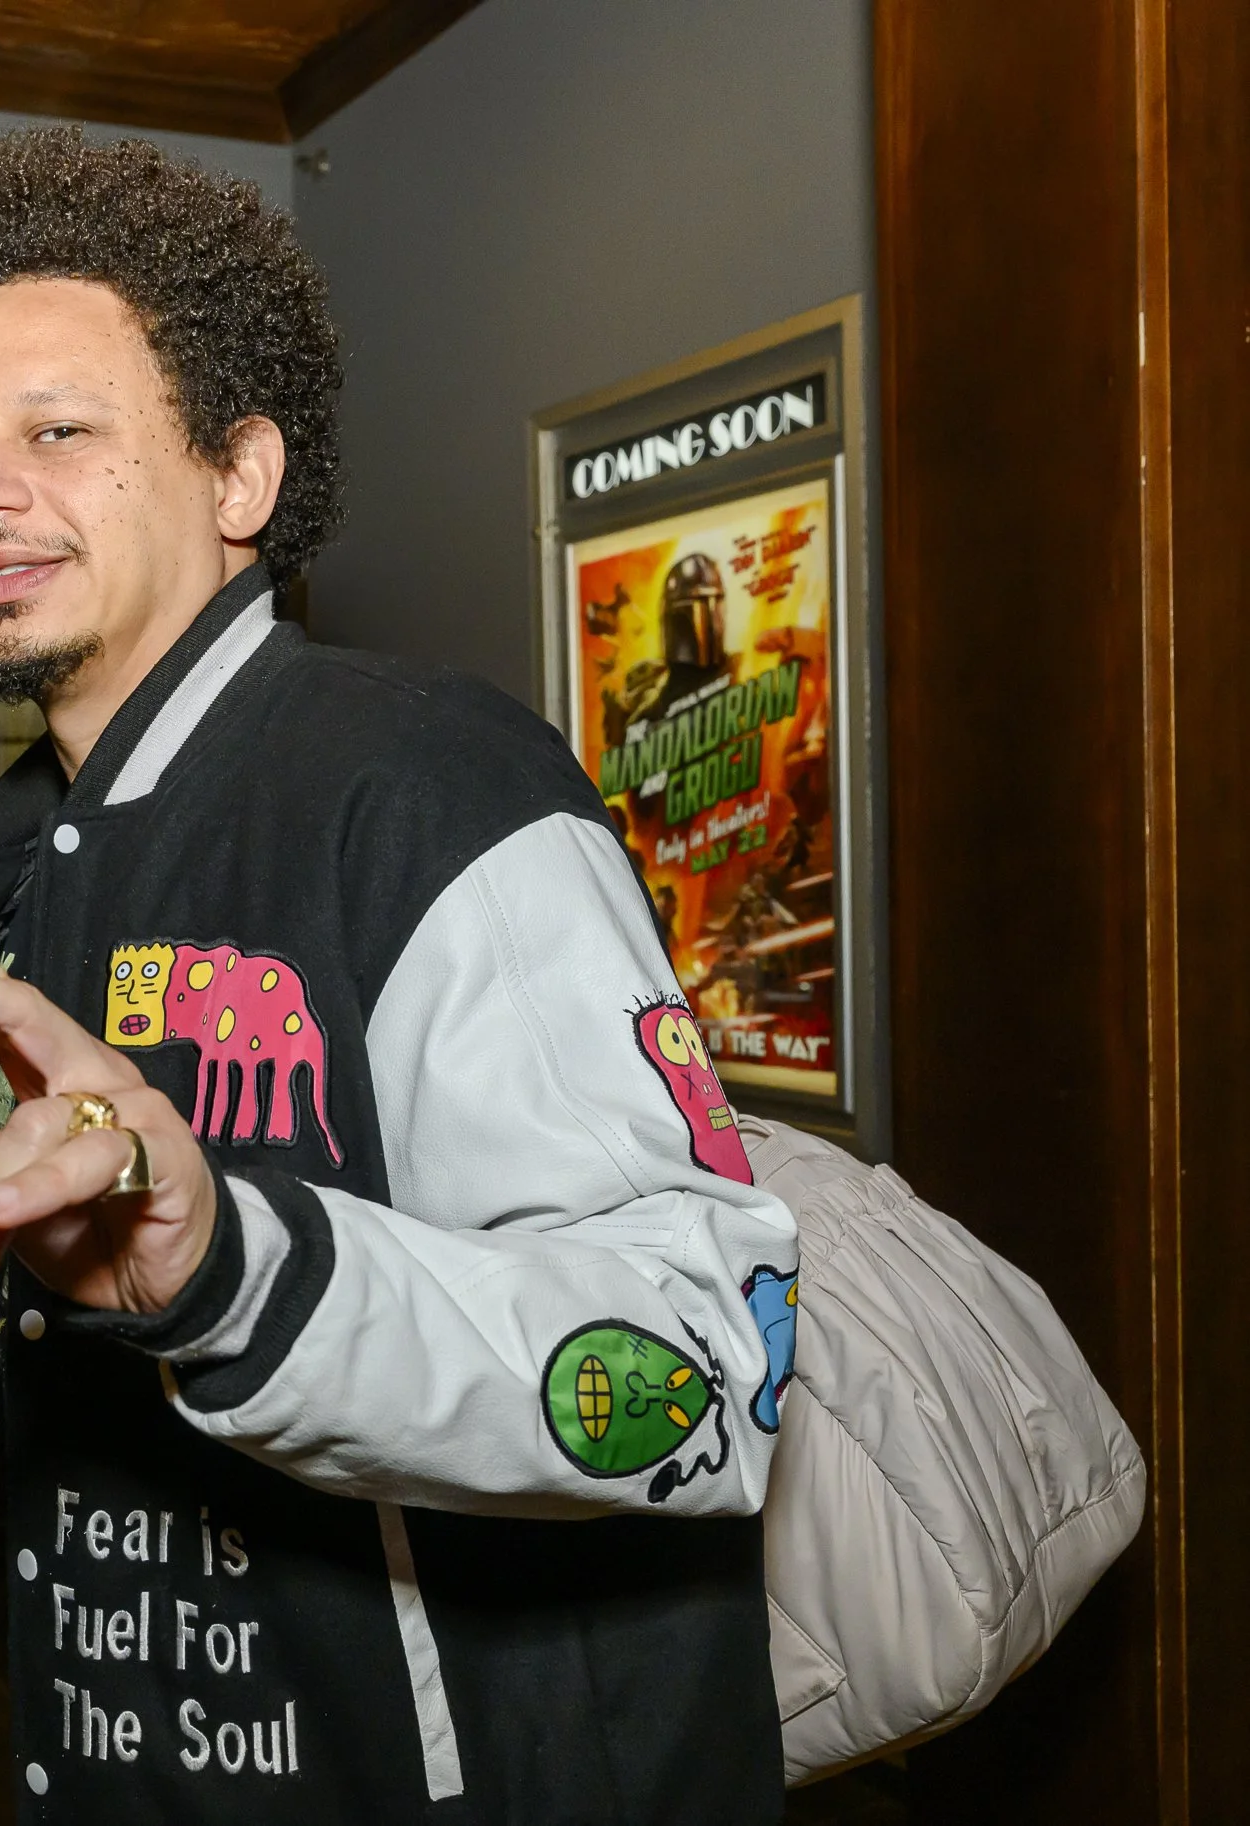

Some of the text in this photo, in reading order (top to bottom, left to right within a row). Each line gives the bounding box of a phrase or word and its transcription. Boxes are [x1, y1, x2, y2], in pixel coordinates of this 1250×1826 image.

[572, 384, 814, 499] COMING SOON
[601, 661, 799, 797] MANDALORIAN
[666, 734, 762, 825] GROGU
[691, 842, 729, 873] MAY
[729, 1030, 766, 1057] THE
[54, 1486, 250, 1577] Fear is
[53, 1583, 260, 1674] Fuel For
[53, 1678, 300, 1776] The Soul
